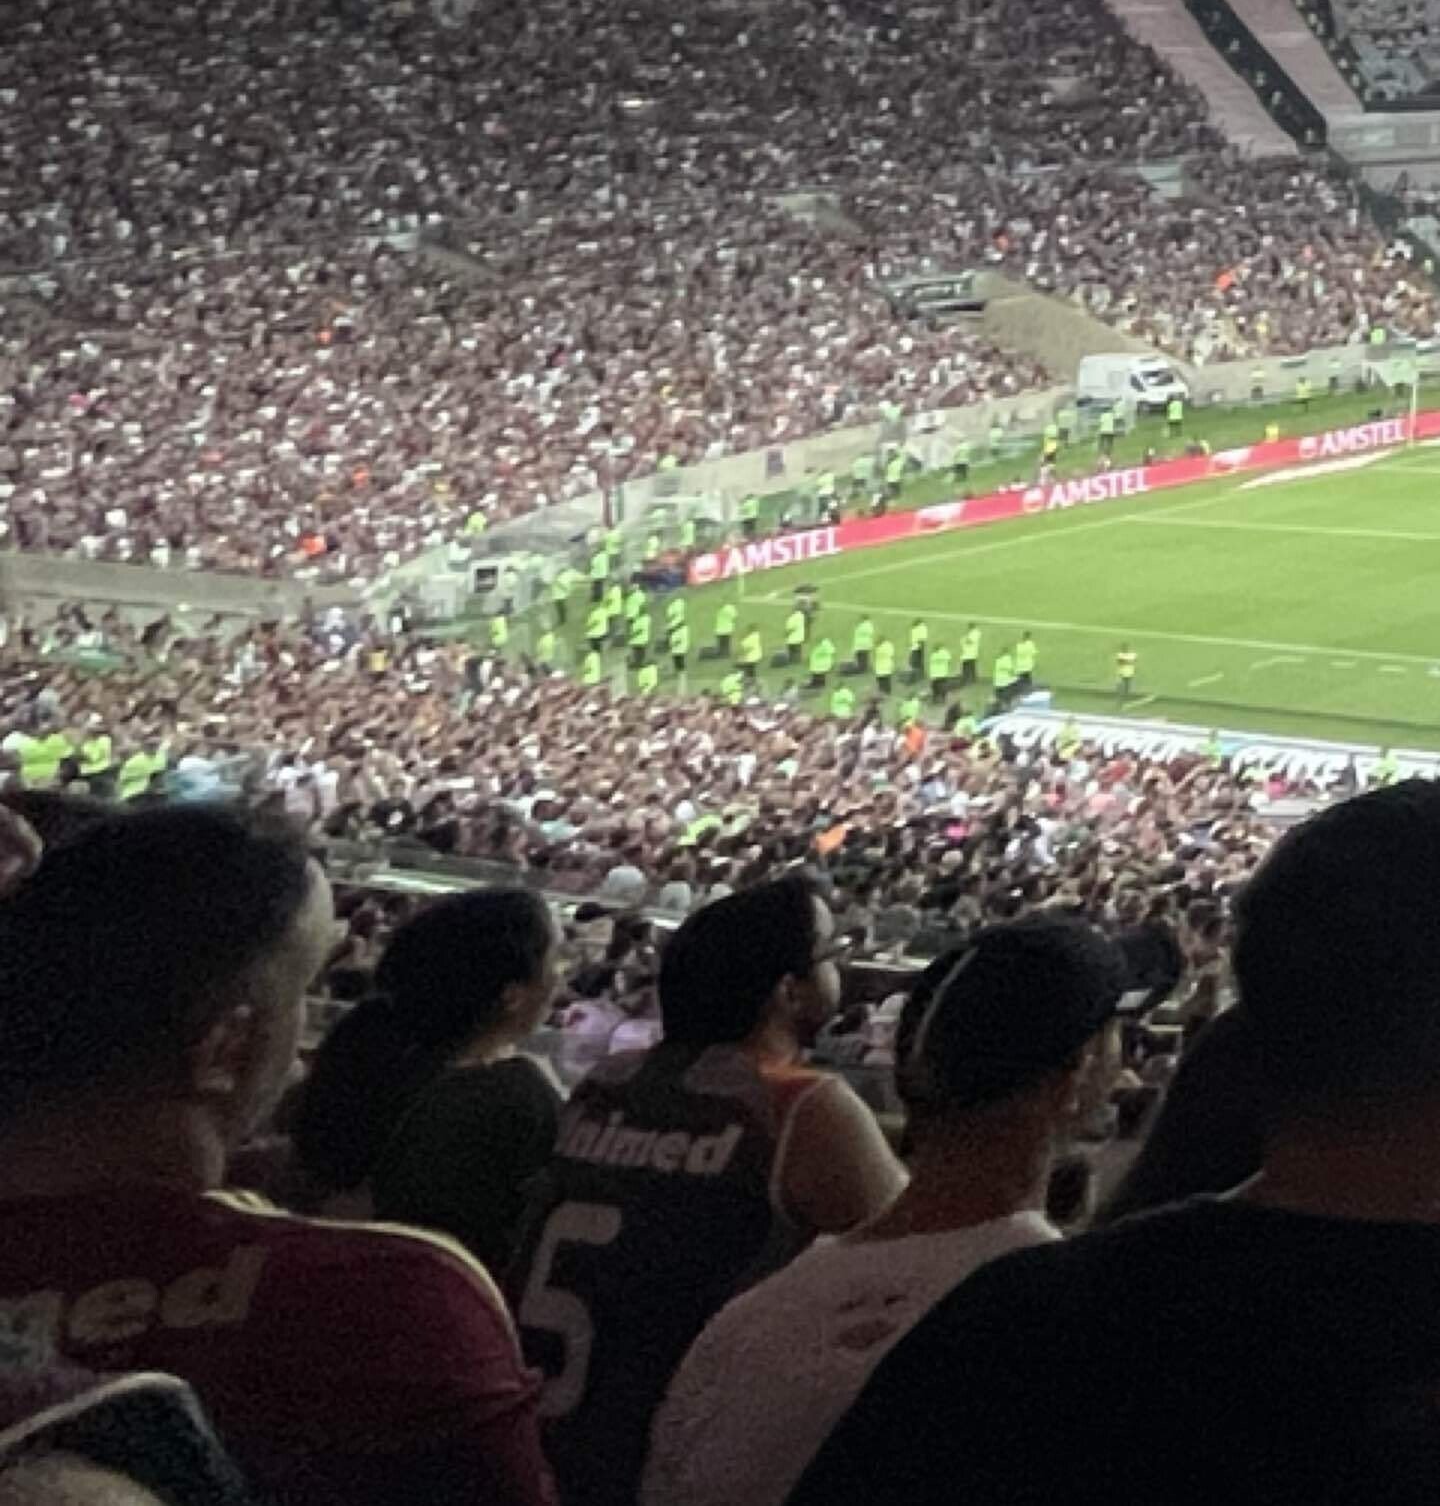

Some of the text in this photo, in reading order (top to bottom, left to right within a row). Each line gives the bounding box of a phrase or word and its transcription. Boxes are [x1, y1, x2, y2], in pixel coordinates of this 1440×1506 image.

[1319, 417, 1406, 454] AMSTEL
[1047, 465, 1149, 510] AMSTEL
[723, 524, 840, 576] AMSTEL
[519, 1200, 622, 1418] 5
